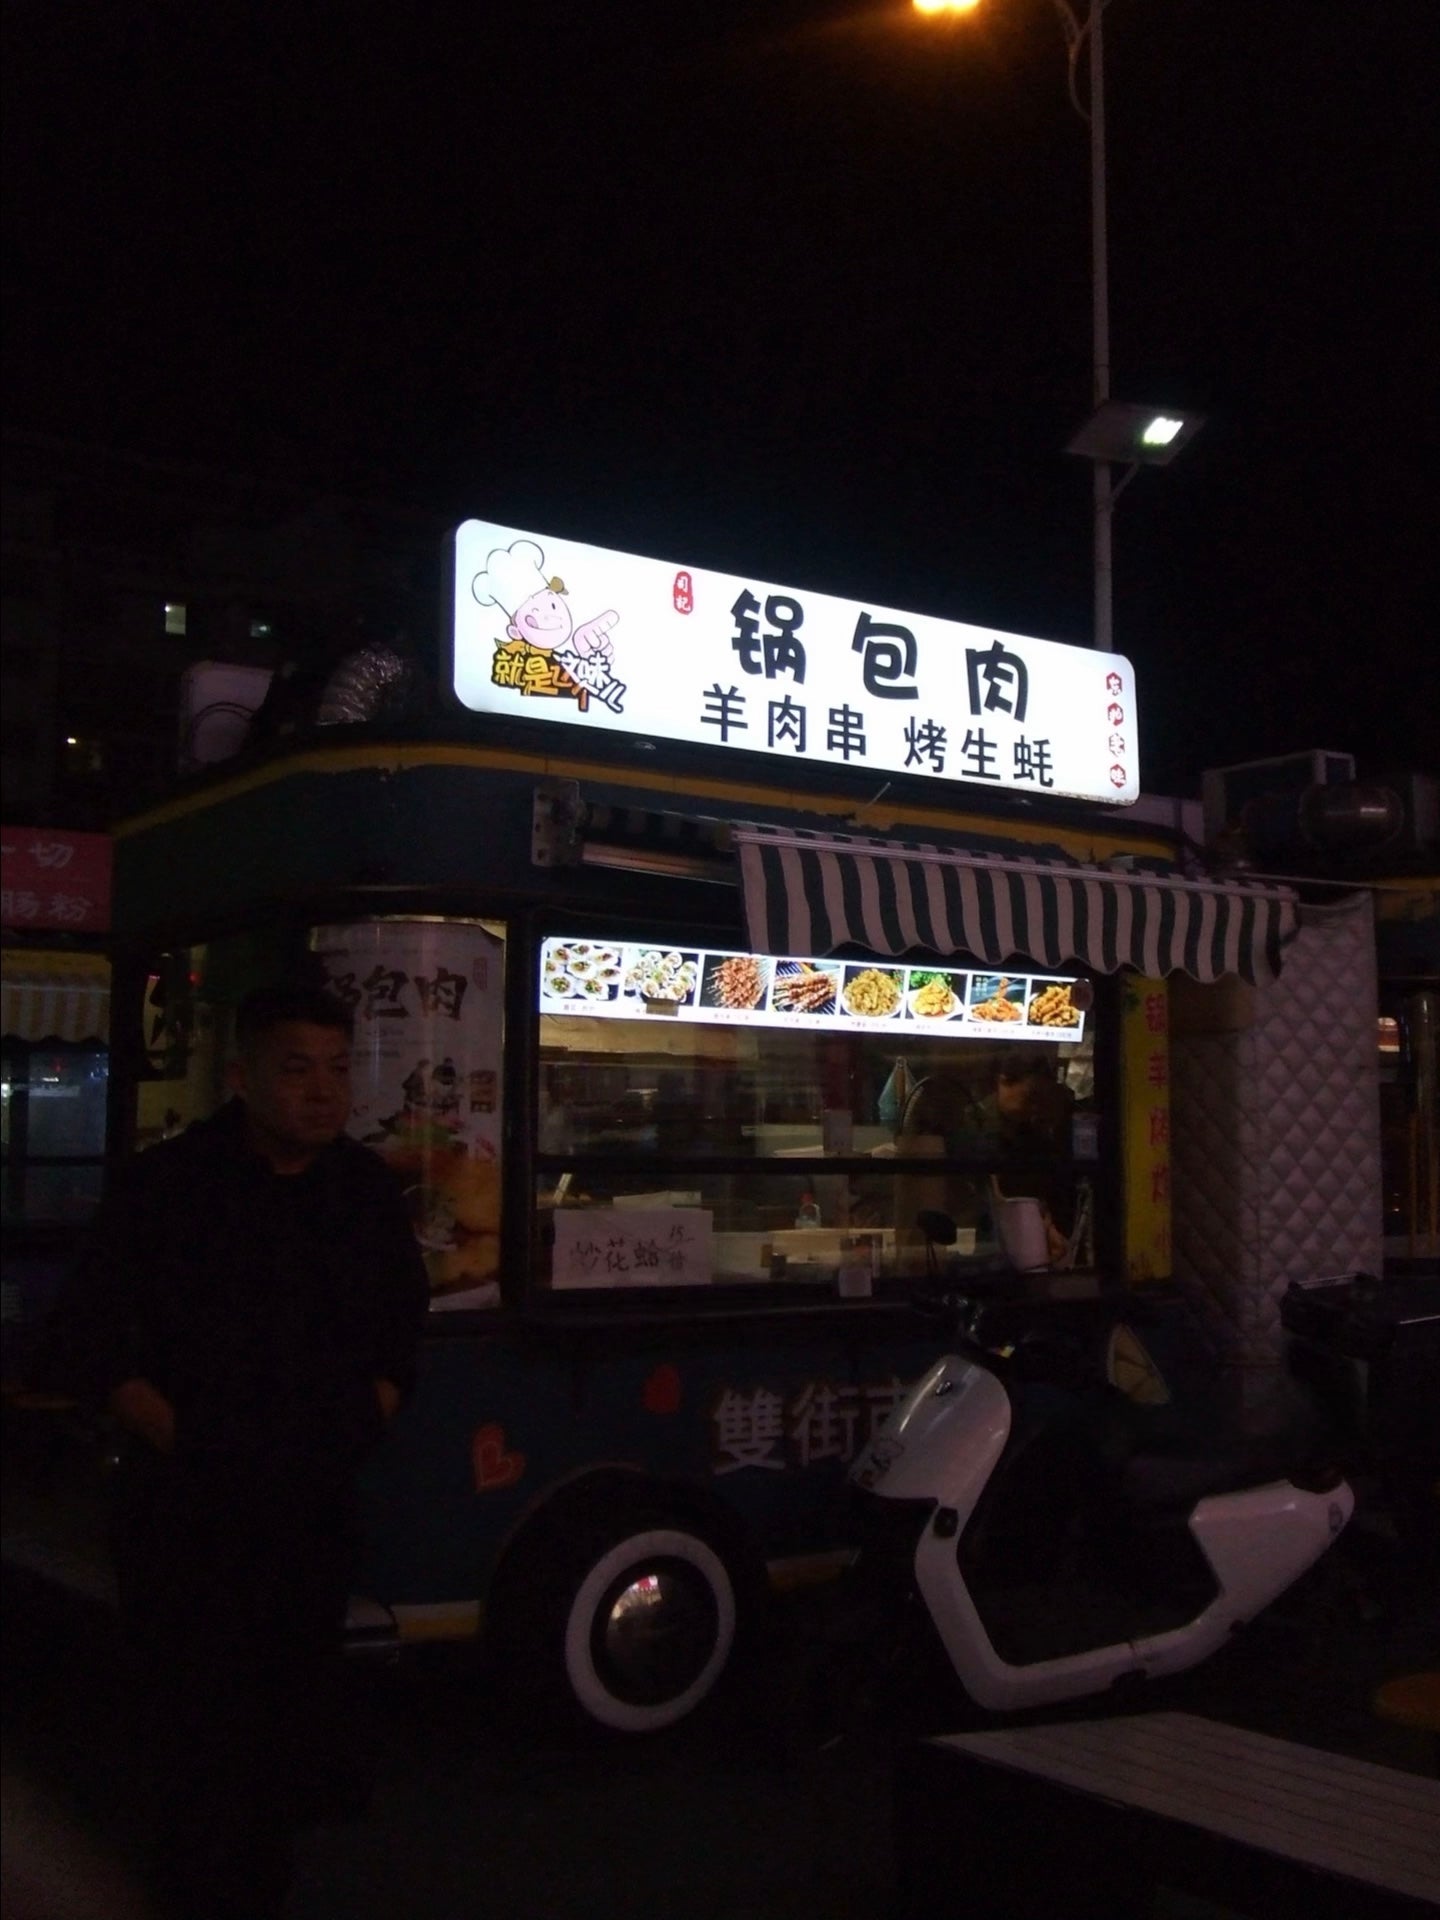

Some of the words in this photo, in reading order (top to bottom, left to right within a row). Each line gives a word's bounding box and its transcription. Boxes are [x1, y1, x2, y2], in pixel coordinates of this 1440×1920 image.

[730, 588, 1029, 723] 锅包肉
[700, 683, 867, 761] 羊肉串
[903, 715, 1054, 788] 烤生蚝
